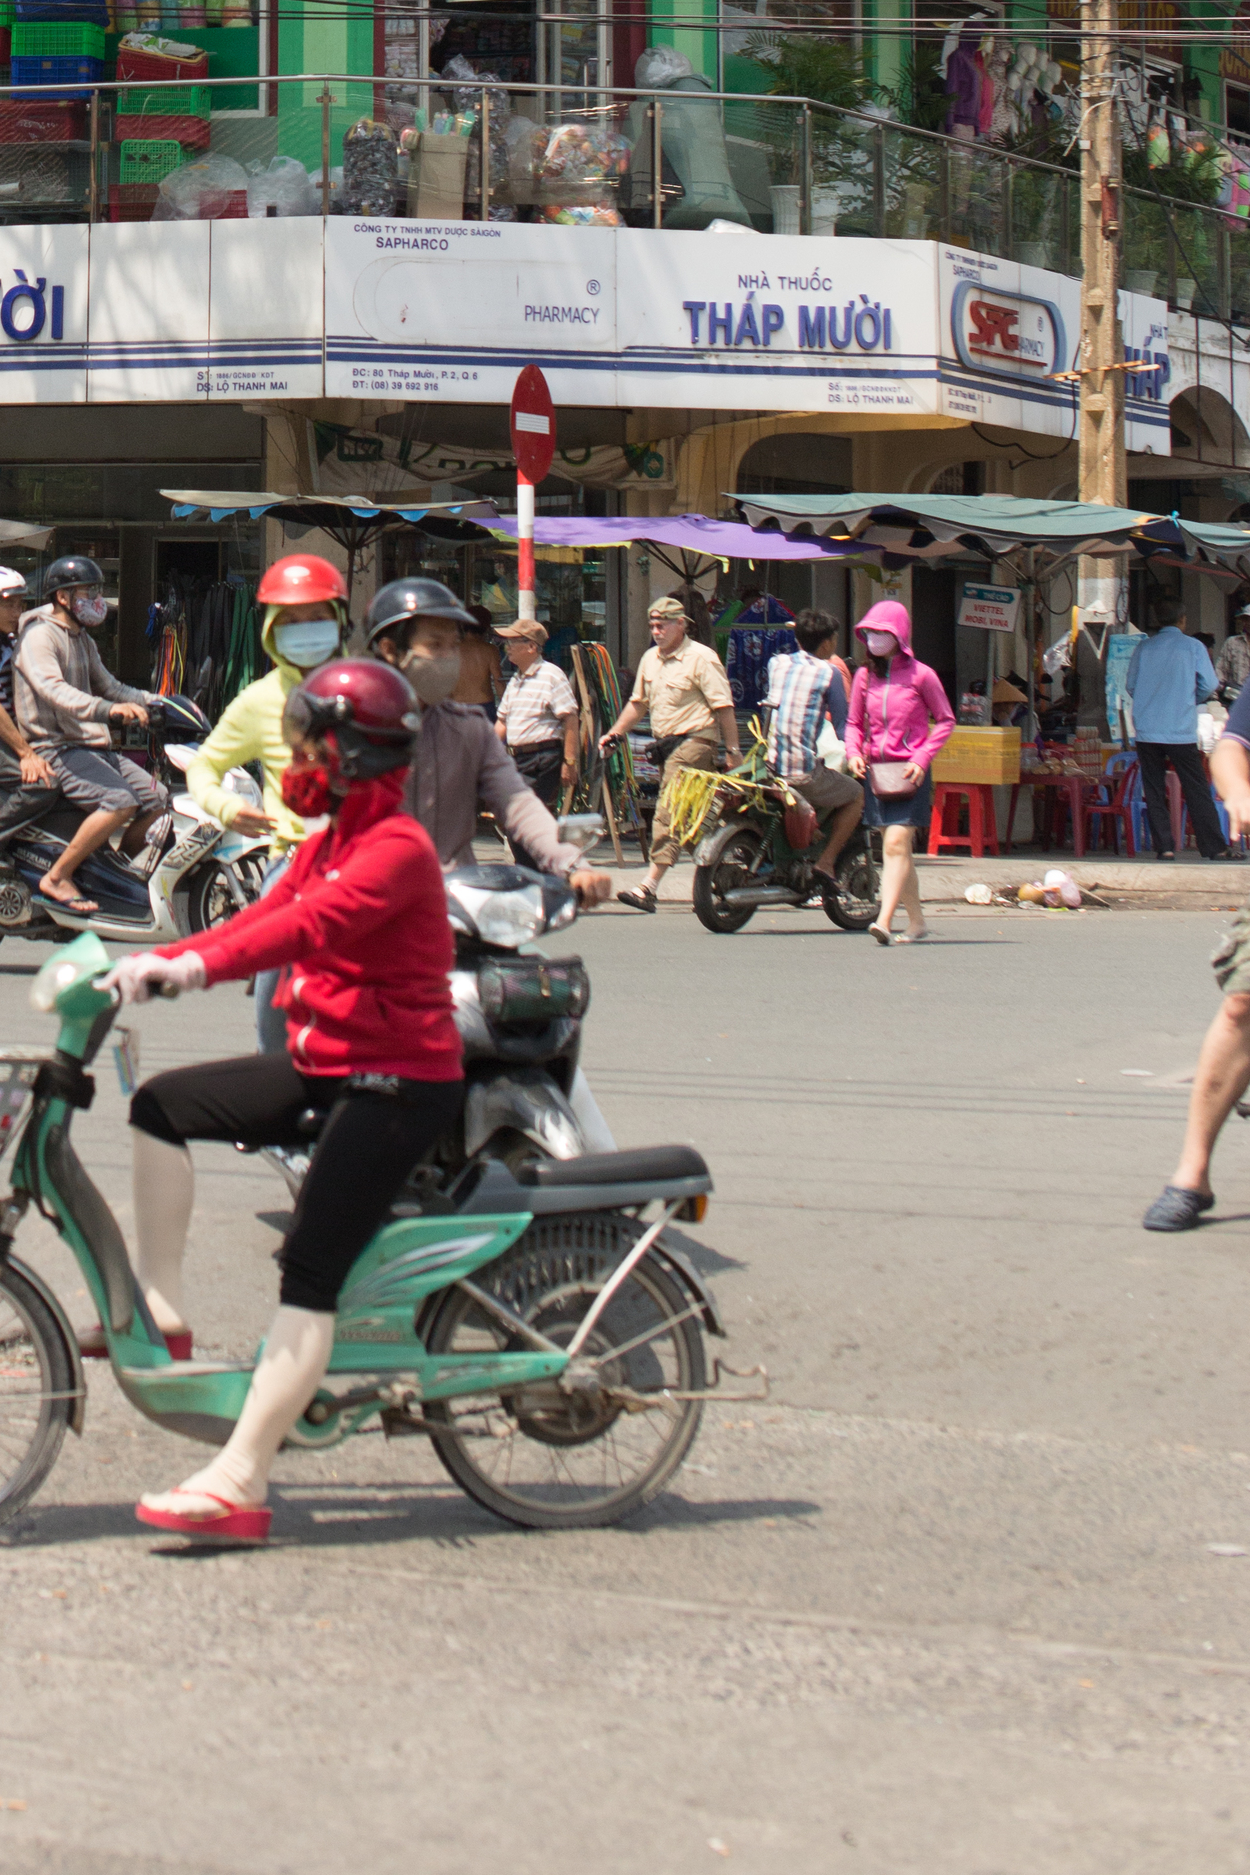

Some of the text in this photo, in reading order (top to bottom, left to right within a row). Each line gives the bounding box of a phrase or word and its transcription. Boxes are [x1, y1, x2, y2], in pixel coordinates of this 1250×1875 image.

[353, 222, 382, 233] CÔNG
[385, 225, 398, 234] TY
[400, 226, 423, 235] TNHH
[424, 226, 443, 235] MTV
[445, 227, 469, 238] DƯỢC
[375, 236, 449, 251] SAPHARCO
[737, 266, 834, 293] NHÀ THUỐC
[523, 303, 600, 325] PHARMACY
[683, 291, 893, 352] THÁP MƯỜI
[372, 369, 384, 377] 80
[388, 369, 410, 379] Tháp
[232, 382, 266, 391] THANH
[269, 381, 288, 390] MAI
[371, 381, 389, 391] (08)
[391, 382, 402, 390] 39
[405, 382, 421, 390] 692
[424, 383, 439, 391] 916
[846, 392, 860, 406] LỘ
[862, 395, 894, 404] THANH
[896, 396, 914, 405] MAI
[973, 603, 1005, 615] VIETTEL
[989, 617, 1009, 628] VINA
[16, 847, 53, 868] SUZUKI
